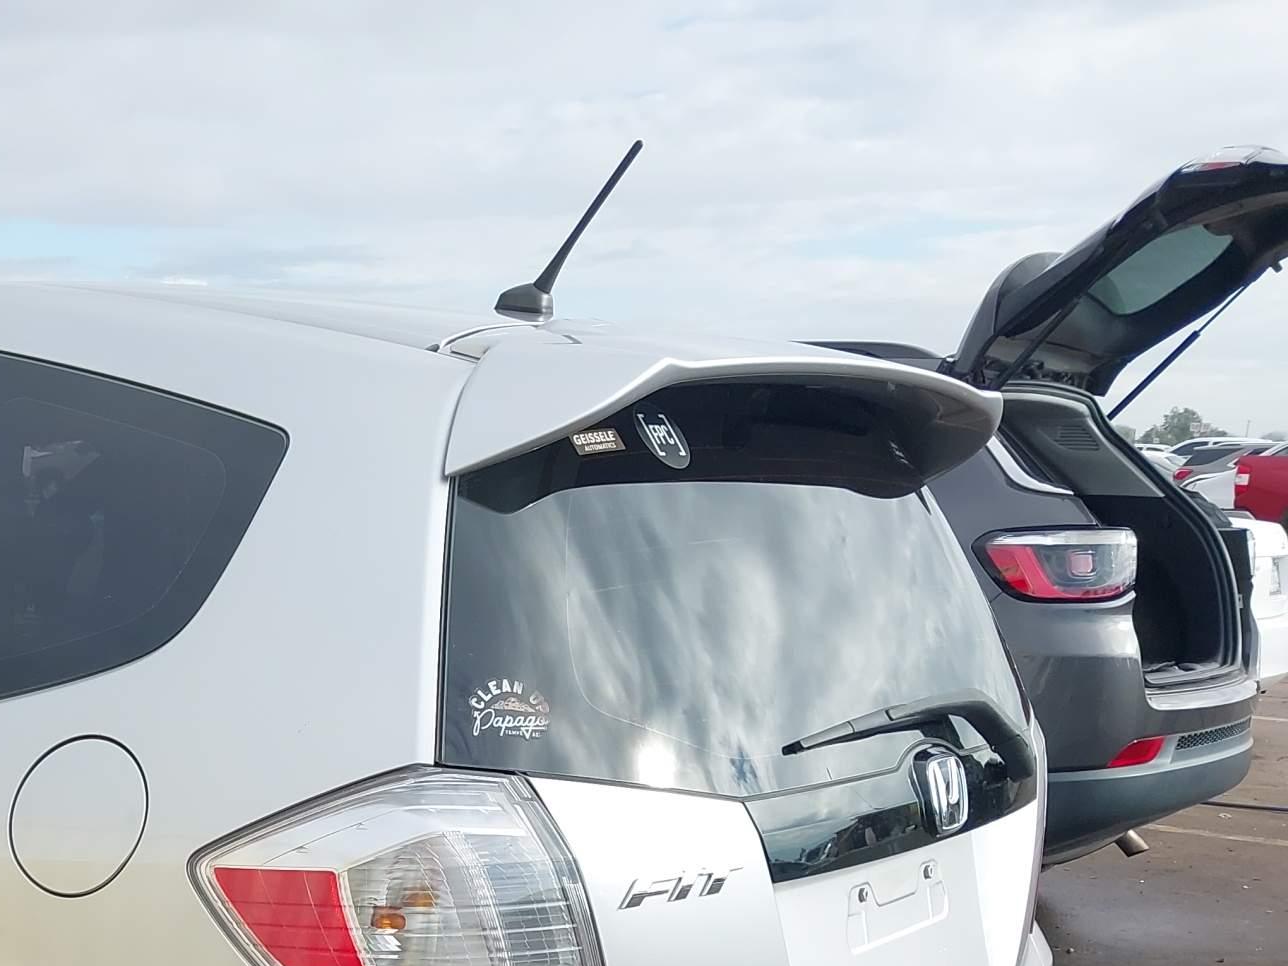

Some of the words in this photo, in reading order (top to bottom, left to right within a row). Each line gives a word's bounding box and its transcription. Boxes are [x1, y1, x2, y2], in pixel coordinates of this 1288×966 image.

[573, 430, 616, 445] GEISSELE
[584, 442, 617, 452] AUTOMATICS
[471, 679, 523, 709] CLEAN
[473, 708, 549, 739] Papago
[615, 864, 744, 911] FIT
